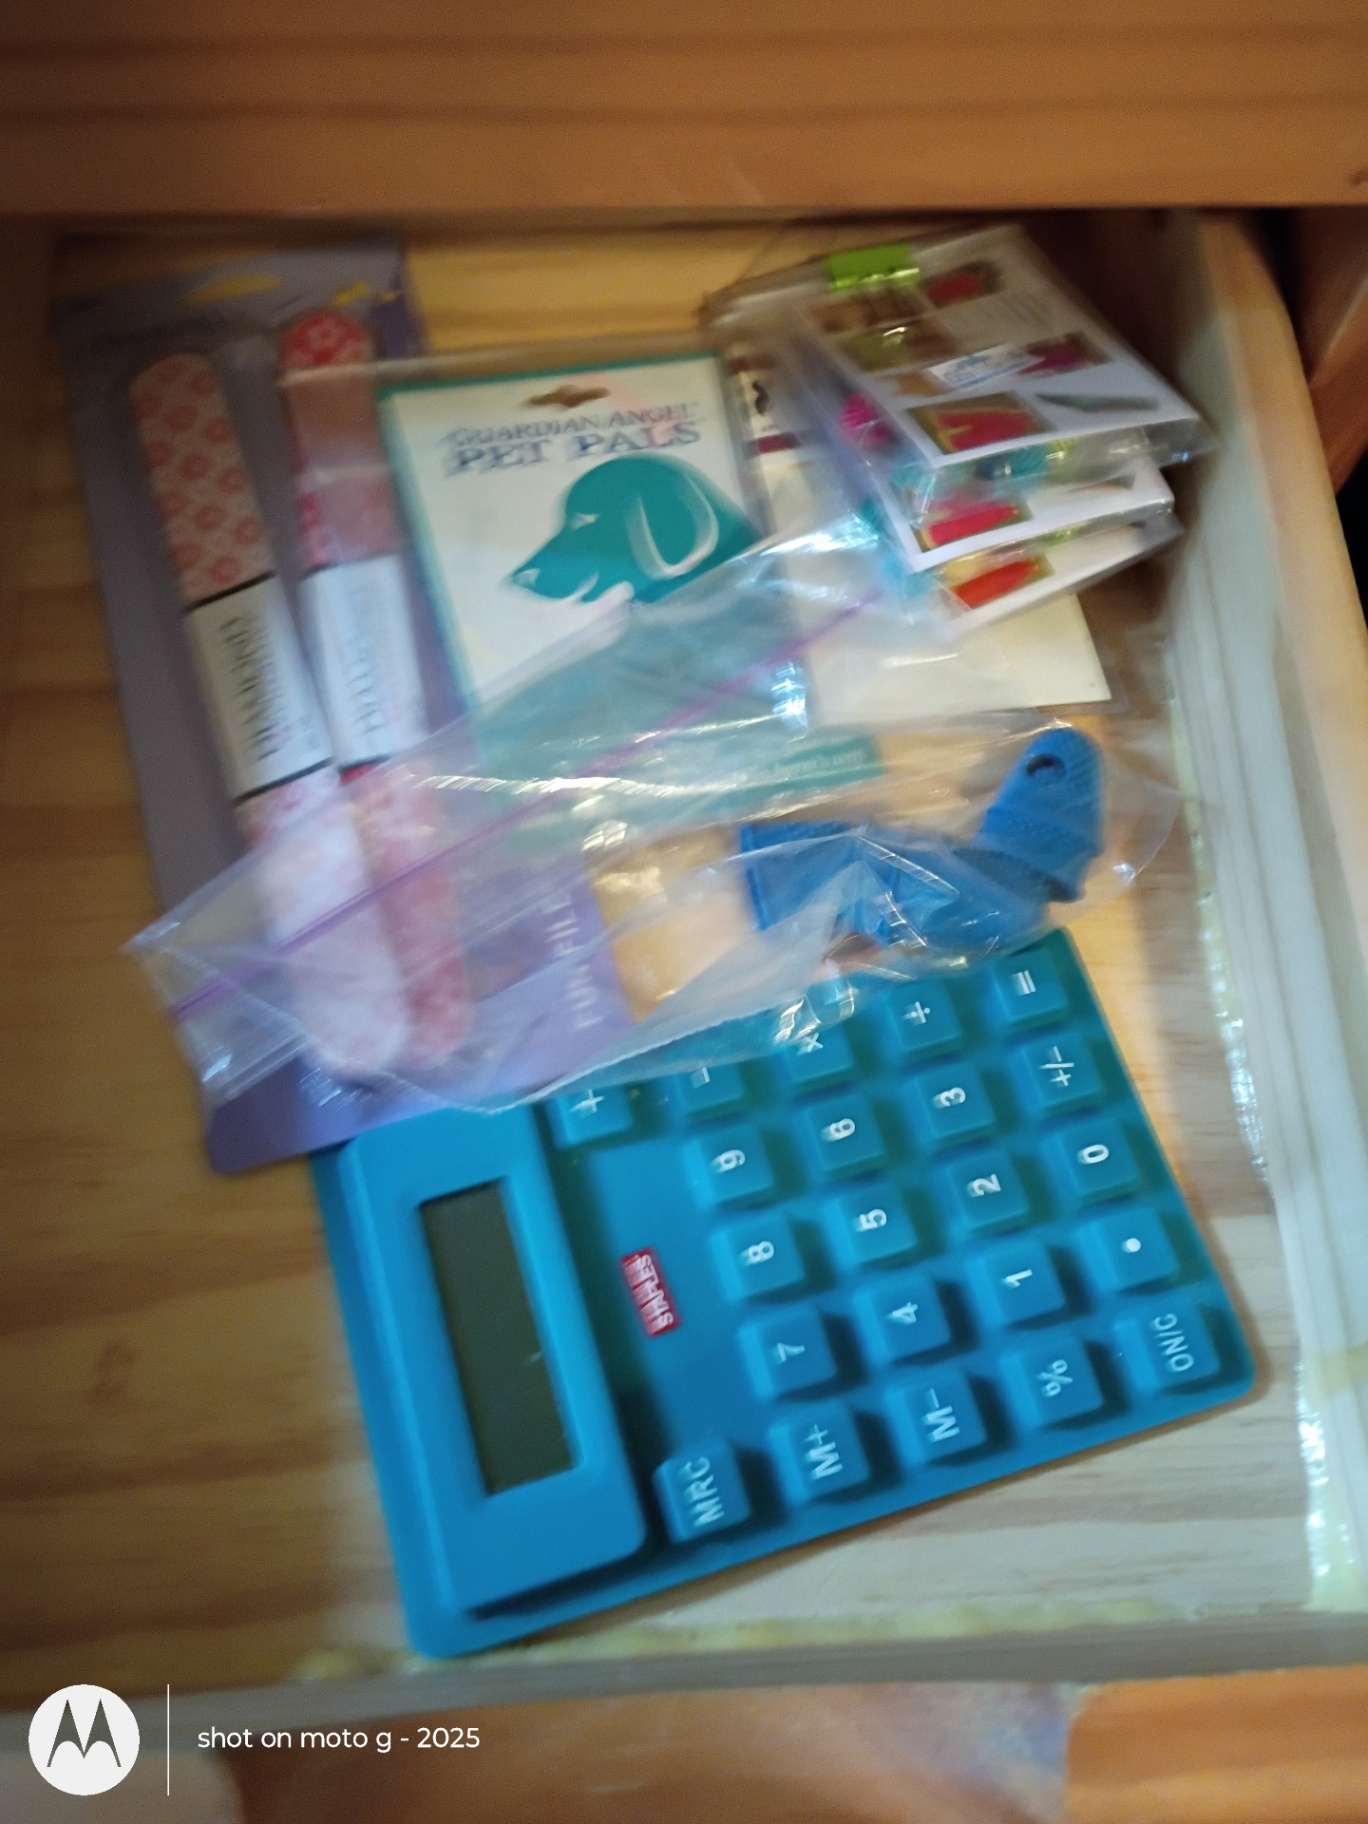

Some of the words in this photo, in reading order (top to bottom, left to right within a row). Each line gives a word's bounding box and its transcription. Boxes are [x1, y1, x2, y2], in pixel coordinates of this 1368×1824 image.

[443, 415, 599, 446] GUARDIAN
[608, 403, 694, 428] ANGEL
[448, 440, 552, 476] PET
[569, 421, 700, 458] PALS
[935, 1087, 966, 1108] 3
[824, 1118, 856, 1141] 6
[713, 1149, 746, 1173] 9
[1079, 1144, 1109, 1164] 0
[969, 1174, 1001, 1197] 2
[857, 1208, 887, 1231] 5
[743, 1240, 775, 1265] 8
[1004, 1269, 1032, 1287] 1
[628, 1252, 675, 1336] STAPLES
[889, 1302, 918, 1324] 4
[776, 1342, 805, 1365] 7
[1151, 1312, 1194, 1373] ON/C
[1038, 1359, 1073, 1397] %
[805, 1424, 843, 1480] M+
[682, 1457, 725, 1527] MRC
